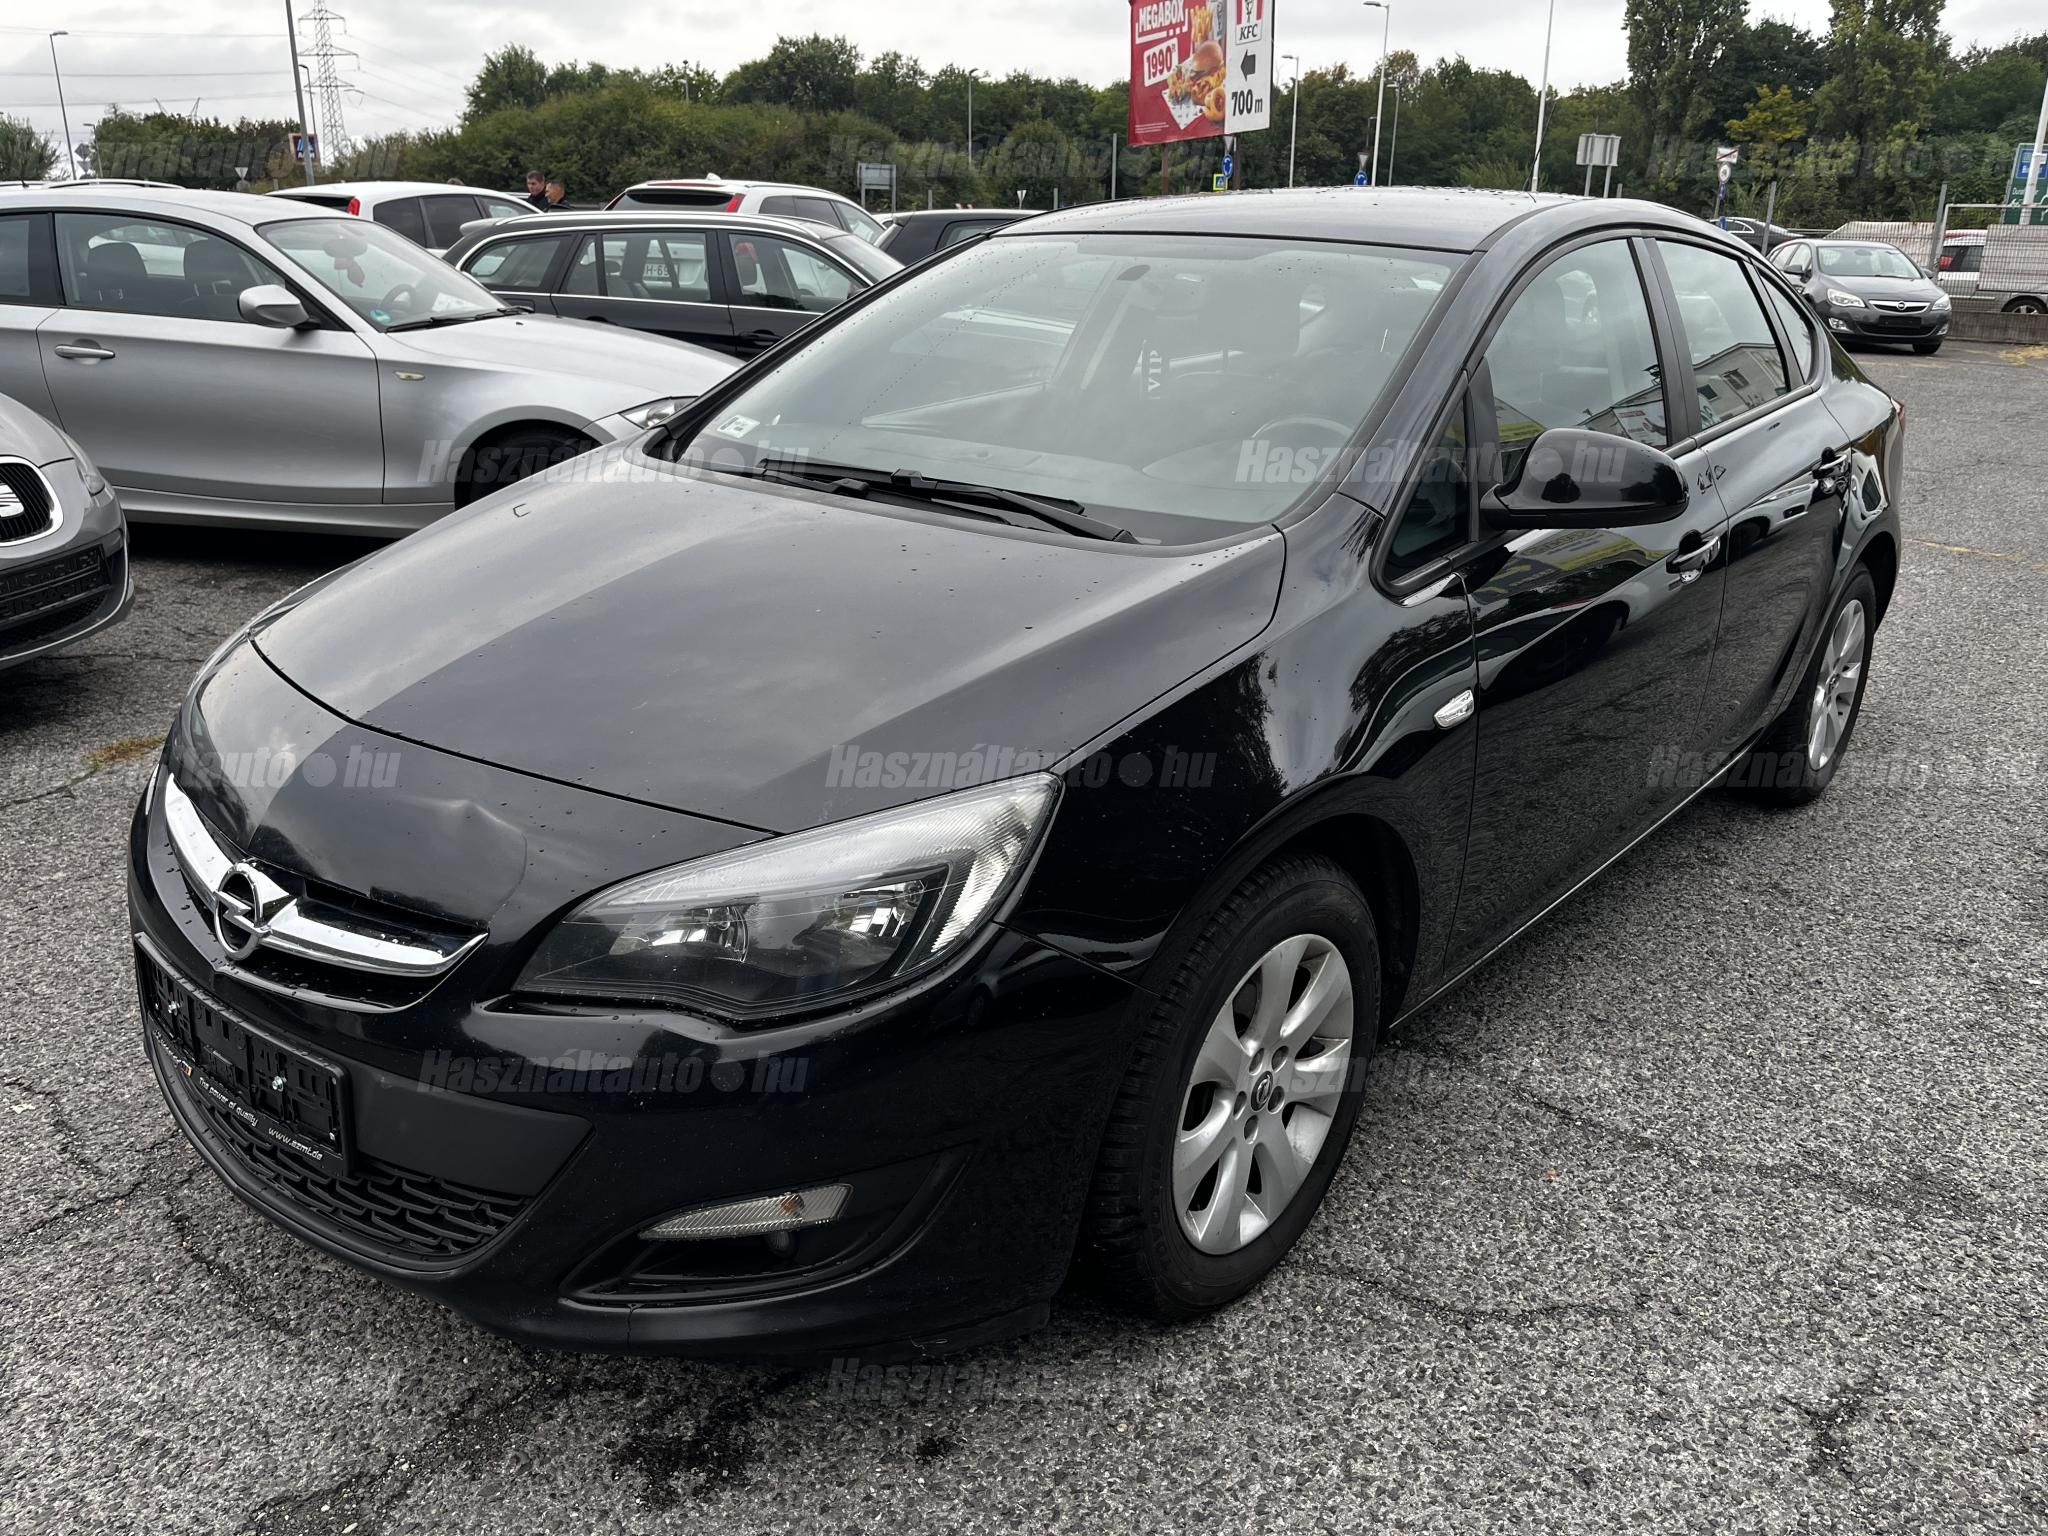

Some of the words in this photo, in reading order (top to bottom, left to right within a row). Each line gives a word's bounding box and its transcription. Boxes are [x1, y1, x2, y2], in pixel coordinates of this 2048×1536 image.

[1139, 0, 1184, 32] MEGABOX
[1239, 24, 1258, 41] KFC
[1231, 89, 1253, 116] 700
[1254, 98, 1263, 113] m
